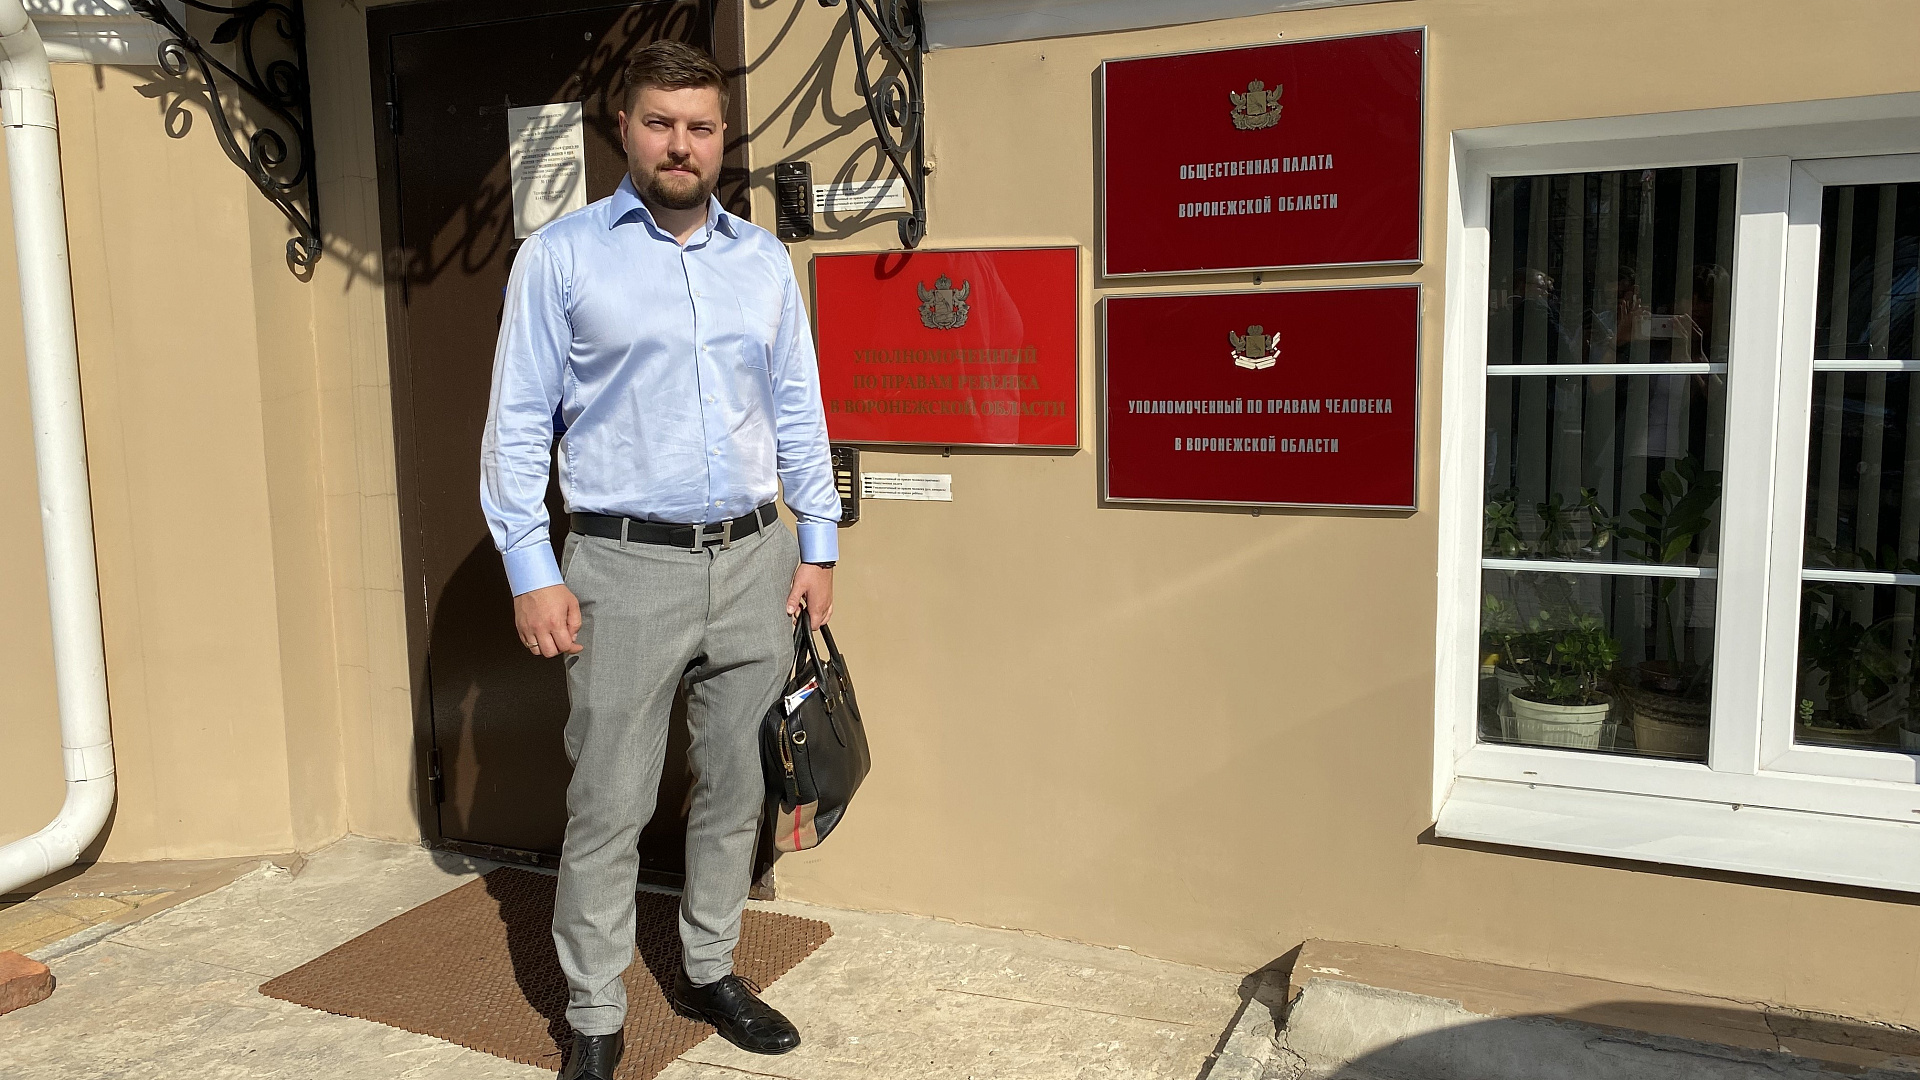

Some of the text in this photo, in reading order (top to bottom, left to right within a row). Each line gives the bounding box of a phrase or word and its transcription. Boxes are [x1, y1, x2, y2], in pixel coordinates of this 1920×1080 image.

[1179, 154, 1334, 180] ОБЩЕСТВЕННАЯ ПАЛАТА
[1178, 193, 1338, 218] ВОРОНЕЖСКОЙ ОБЛАСТИ
[854, 346, 1037, 364] УПОЛНОМОЧЕННЫЙ
[852, 374, 1040, 391] ПО ПРАВАМ РЕБЕНКА
[829, 396, 1066, 417] В ВОРОНЕЖСКОЙ ОБЛАСТИ
[1128, 397, 1393, 414] УПОЛНОМОЧЕННЫЙ ПО ПРАВАМ ЧЕЛОВЕКА
[1174, 435, 1339, 453] В ВОРОНЕЖСКОЙ ОБЛАСТИ
